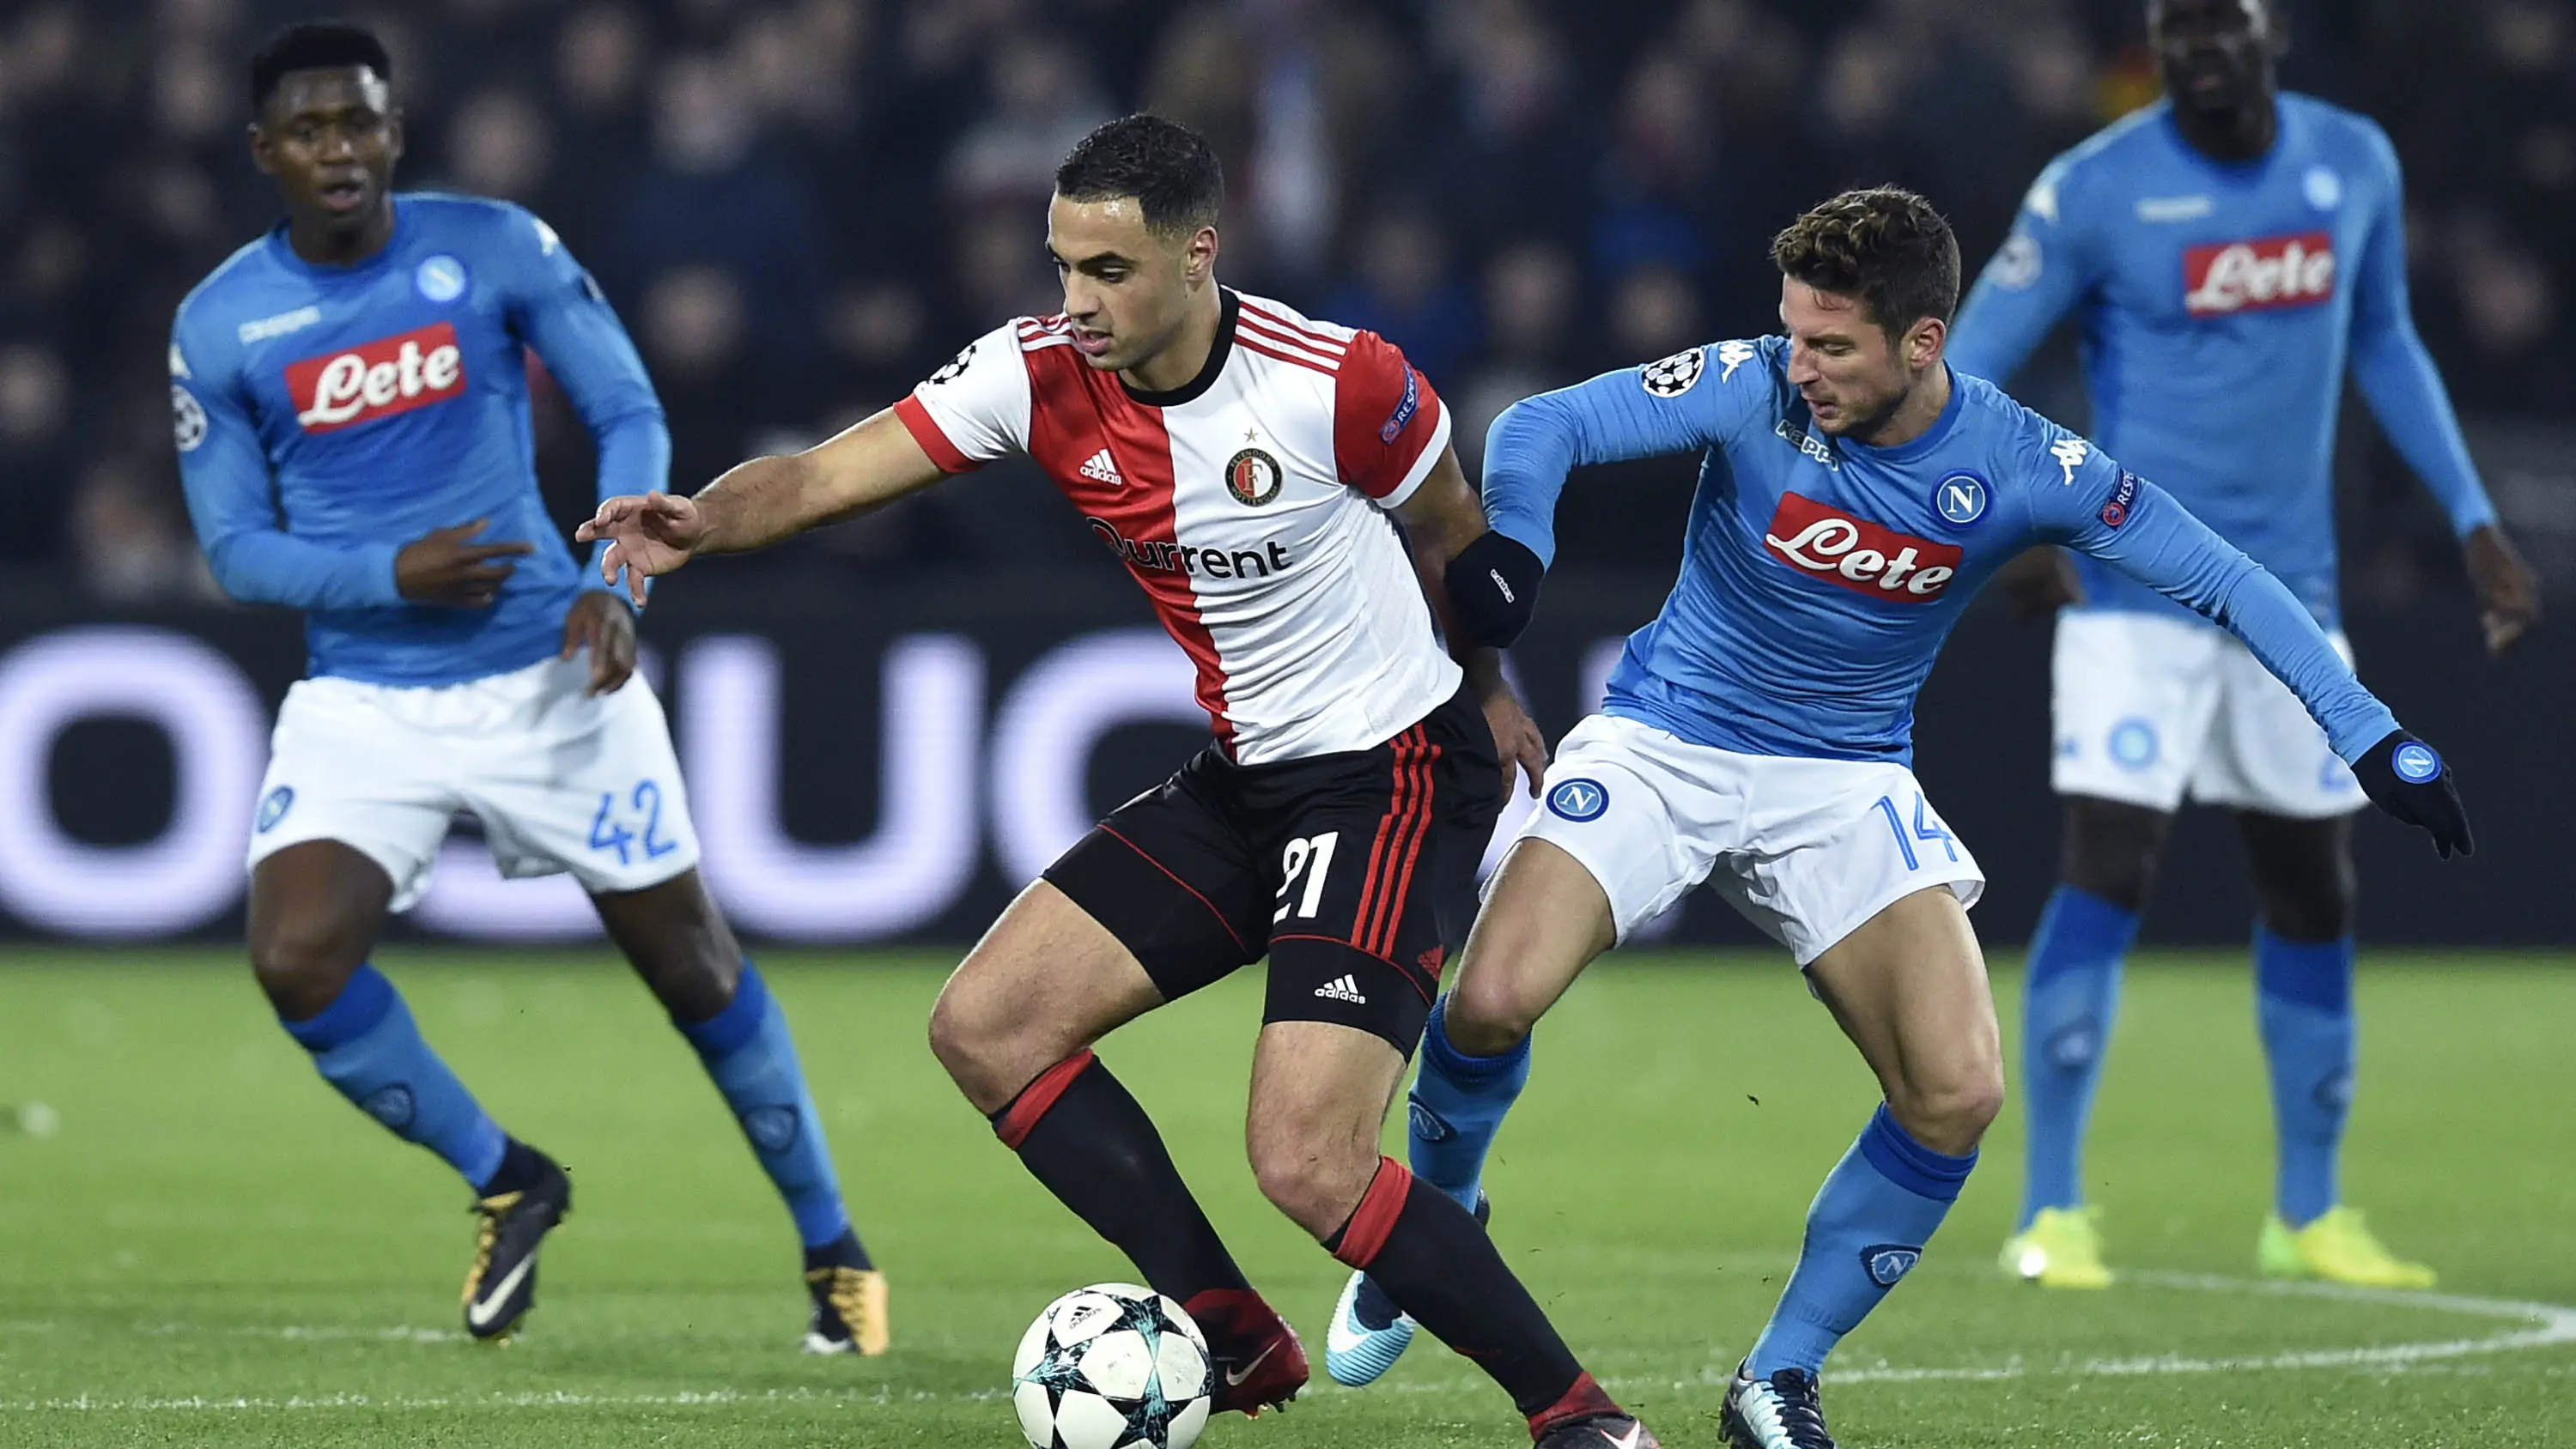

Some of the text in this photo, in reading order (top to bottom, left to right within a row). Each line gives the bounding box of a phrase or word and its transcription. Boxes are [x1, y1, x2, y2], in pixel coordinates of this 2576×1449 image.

[297, 340, 461, 427] Lete
[1079, 466, 1122, 486] adidas
[1947, 485, 1976, 514] N
[1765, 518, 1954, 595] Lete
[587, 779, 677, 865] 42
[1559, 785, 1597, 811] N
[1868, 790, 1959, 871] 14
[1273, 830, 1340, 925] 21
[1314, 986, 1366, 1004] adidas
